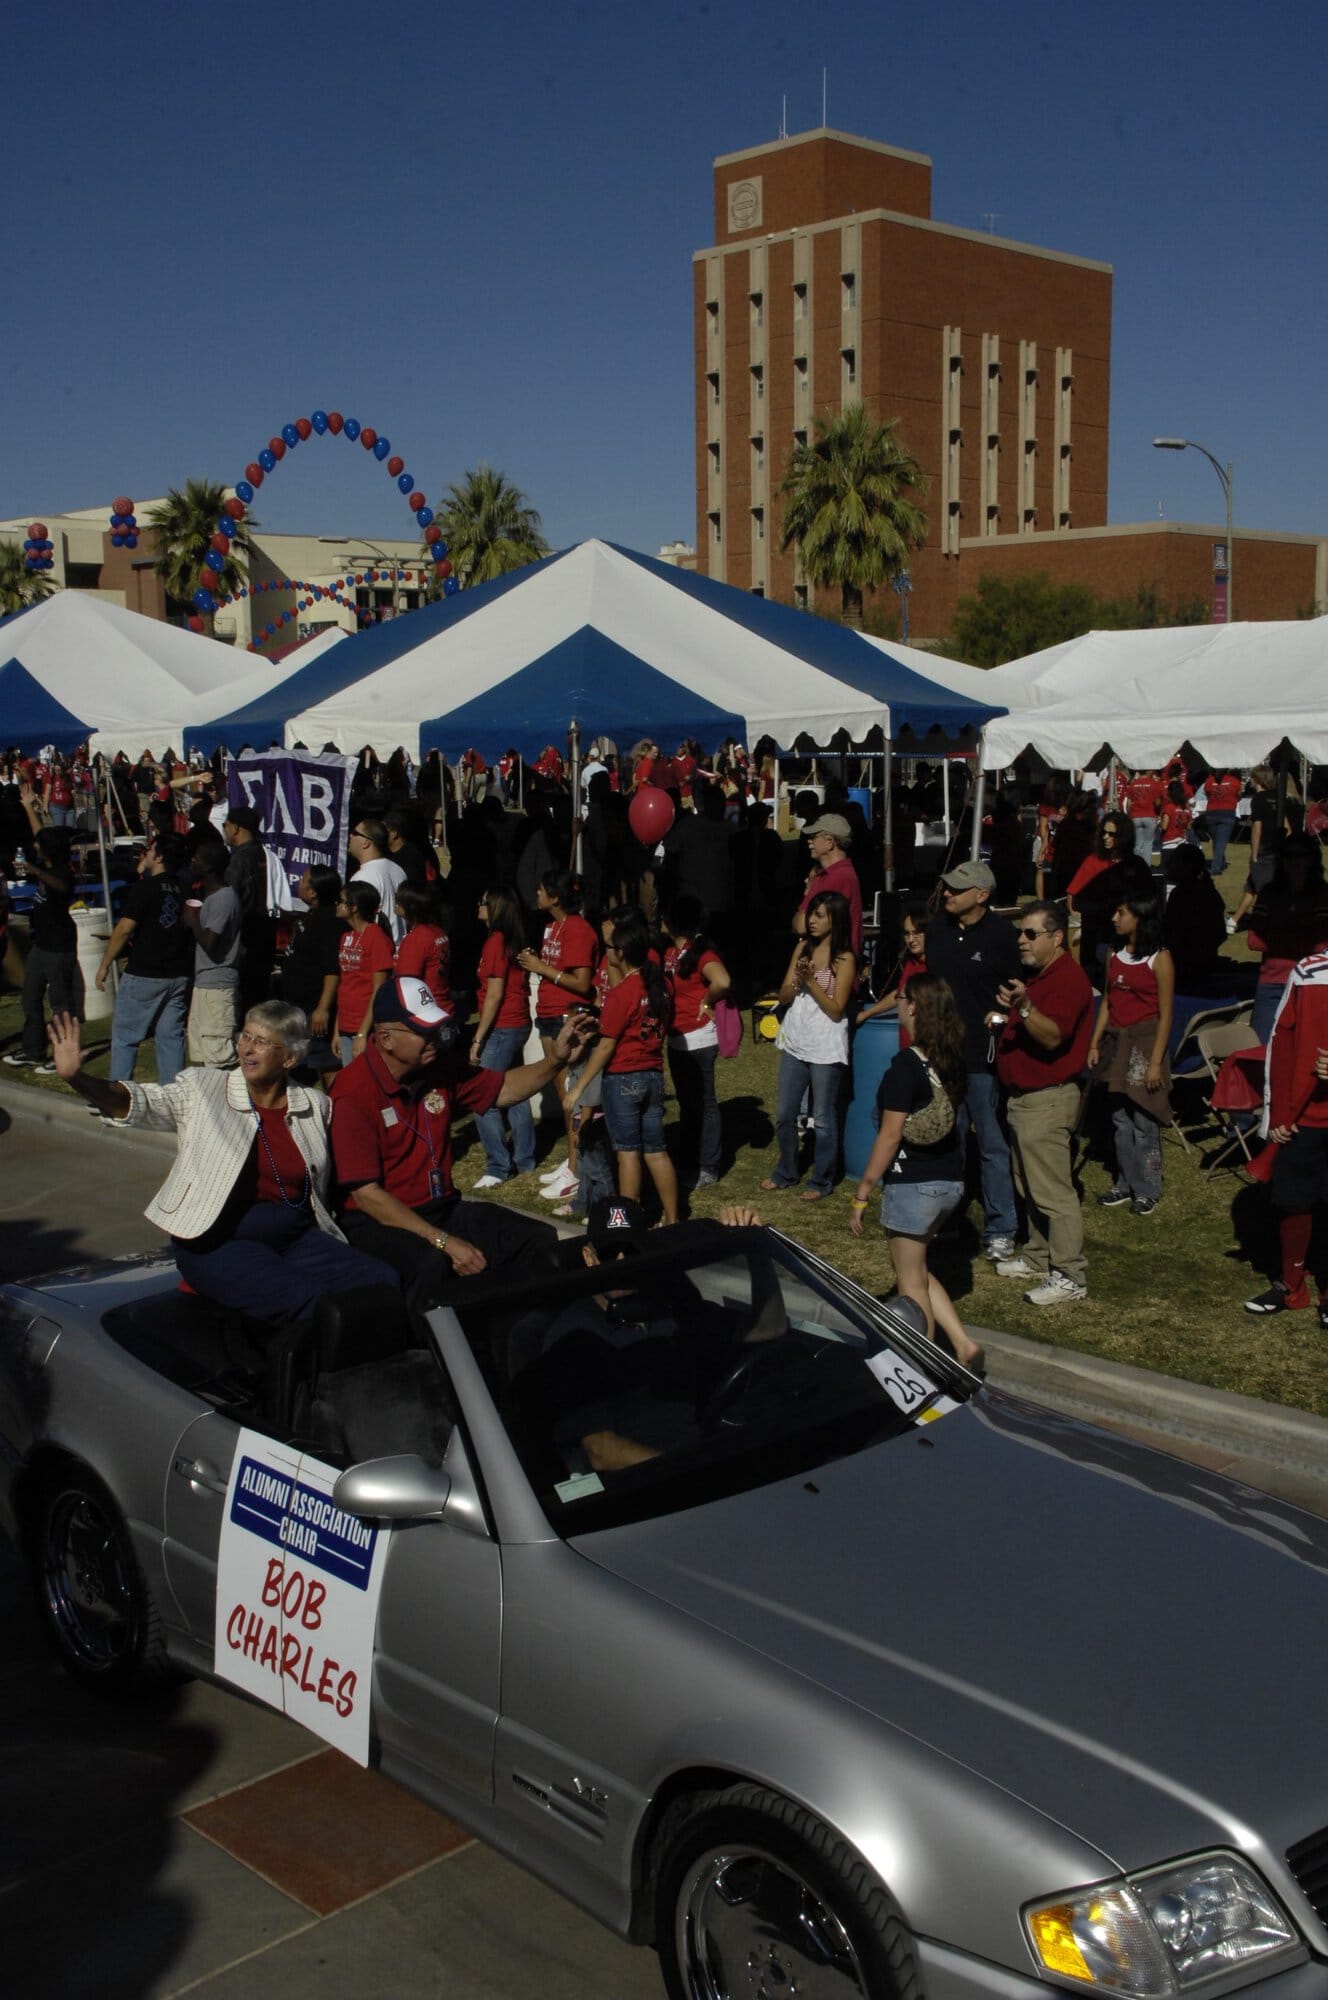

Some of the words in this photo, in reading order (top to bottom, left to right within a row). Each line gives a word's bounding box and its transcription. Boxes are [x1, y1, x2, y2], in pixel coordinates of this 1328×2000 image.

[607, 1207, 631, 1228] A
[884, 1367, 927, 1404] 26
[240, 1466, 291, 1509] ALUMNI
[290, 1489, 372, 1550] ASSOCIATION
[279, 1516, 318, 1556] CHAIR
[262, 1558, 326, 1630] BOB
[226, 1604, 357, 1718] CHARLES
